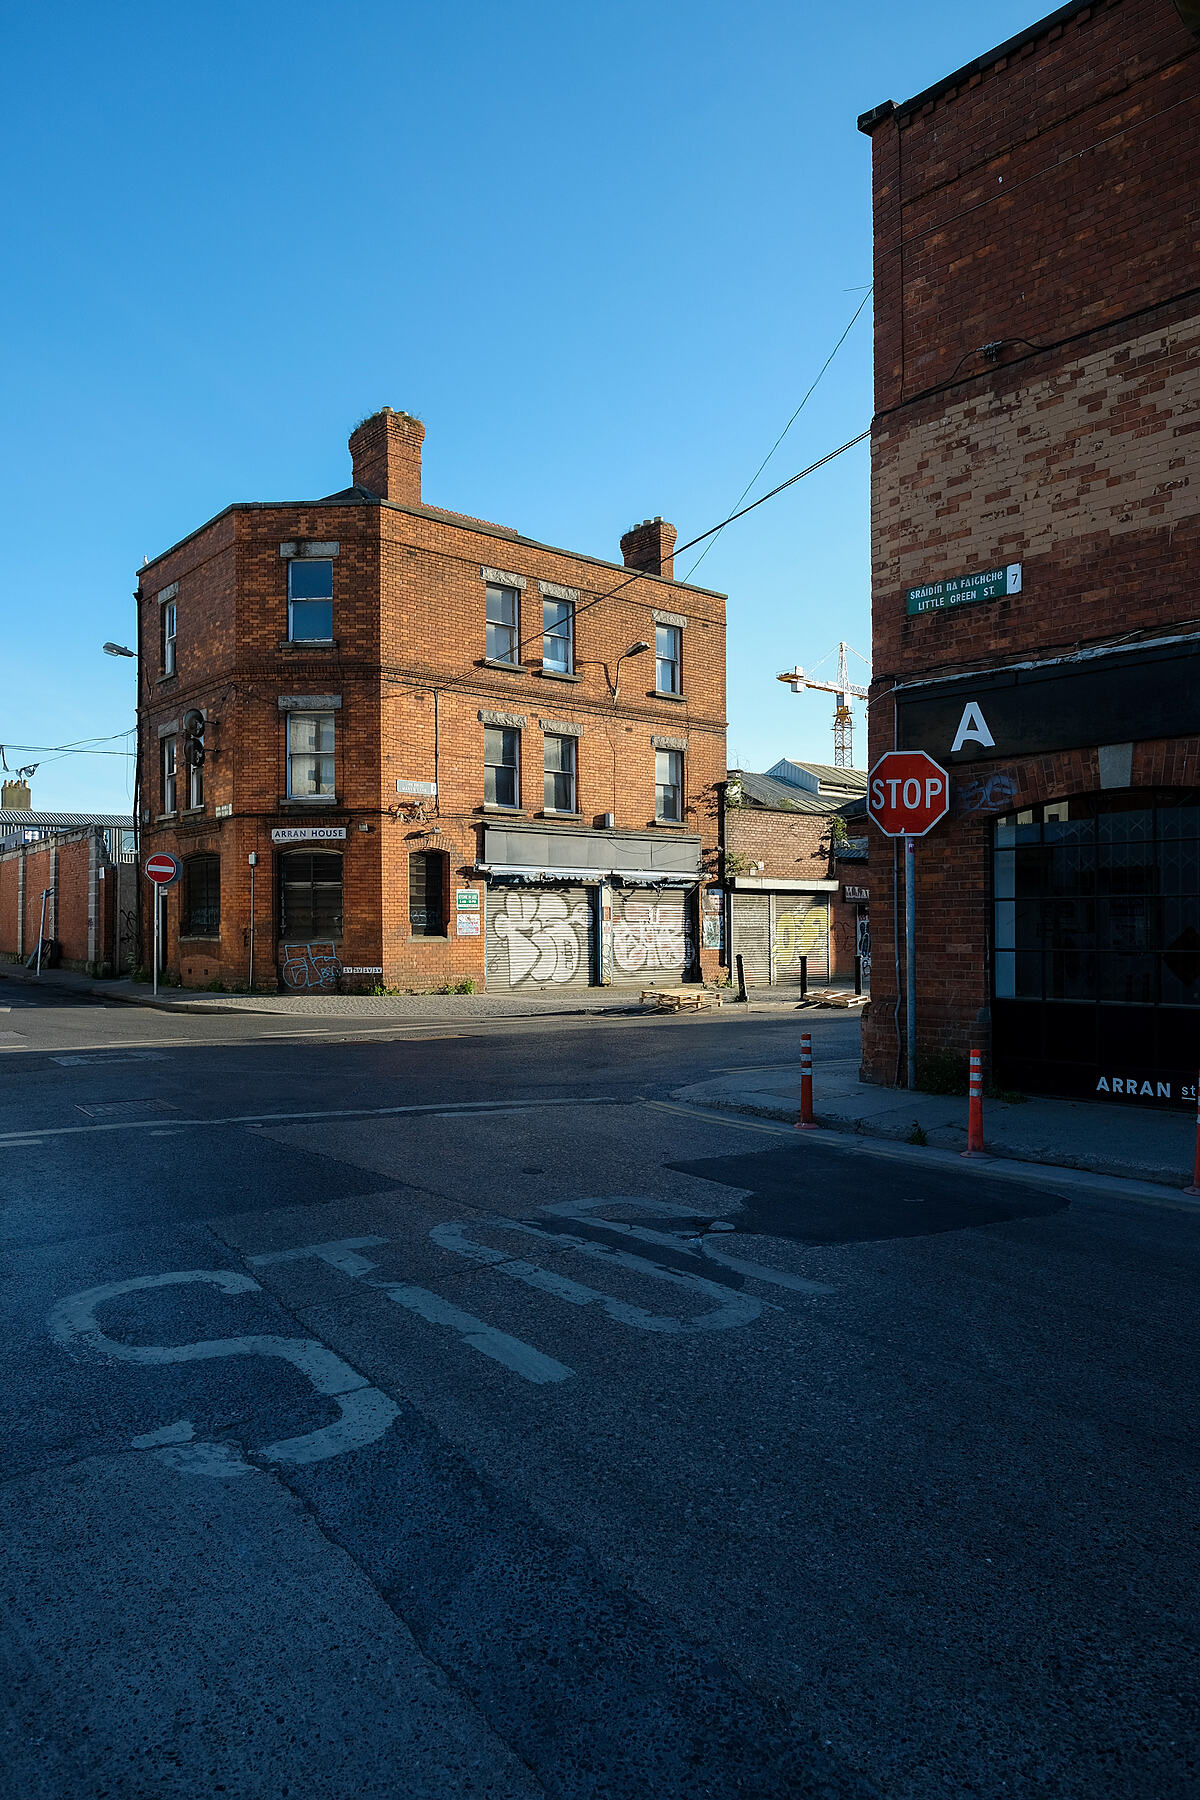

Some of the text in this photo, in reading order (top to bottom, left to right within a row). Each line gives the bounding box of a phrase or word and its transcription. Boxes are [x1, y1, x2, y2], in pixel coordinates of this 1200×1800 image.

[1011, 573, 1019, 585] 7
[918, 586, 995, 611] LITTLE GREEN ST.
[951, 701, 996, 752] A
[871, 778, 943, 810] STOP
[274, 829, 343, 838] ARRAN HOUSE
[1096, 1076, 1171, 1098] ARRAN
